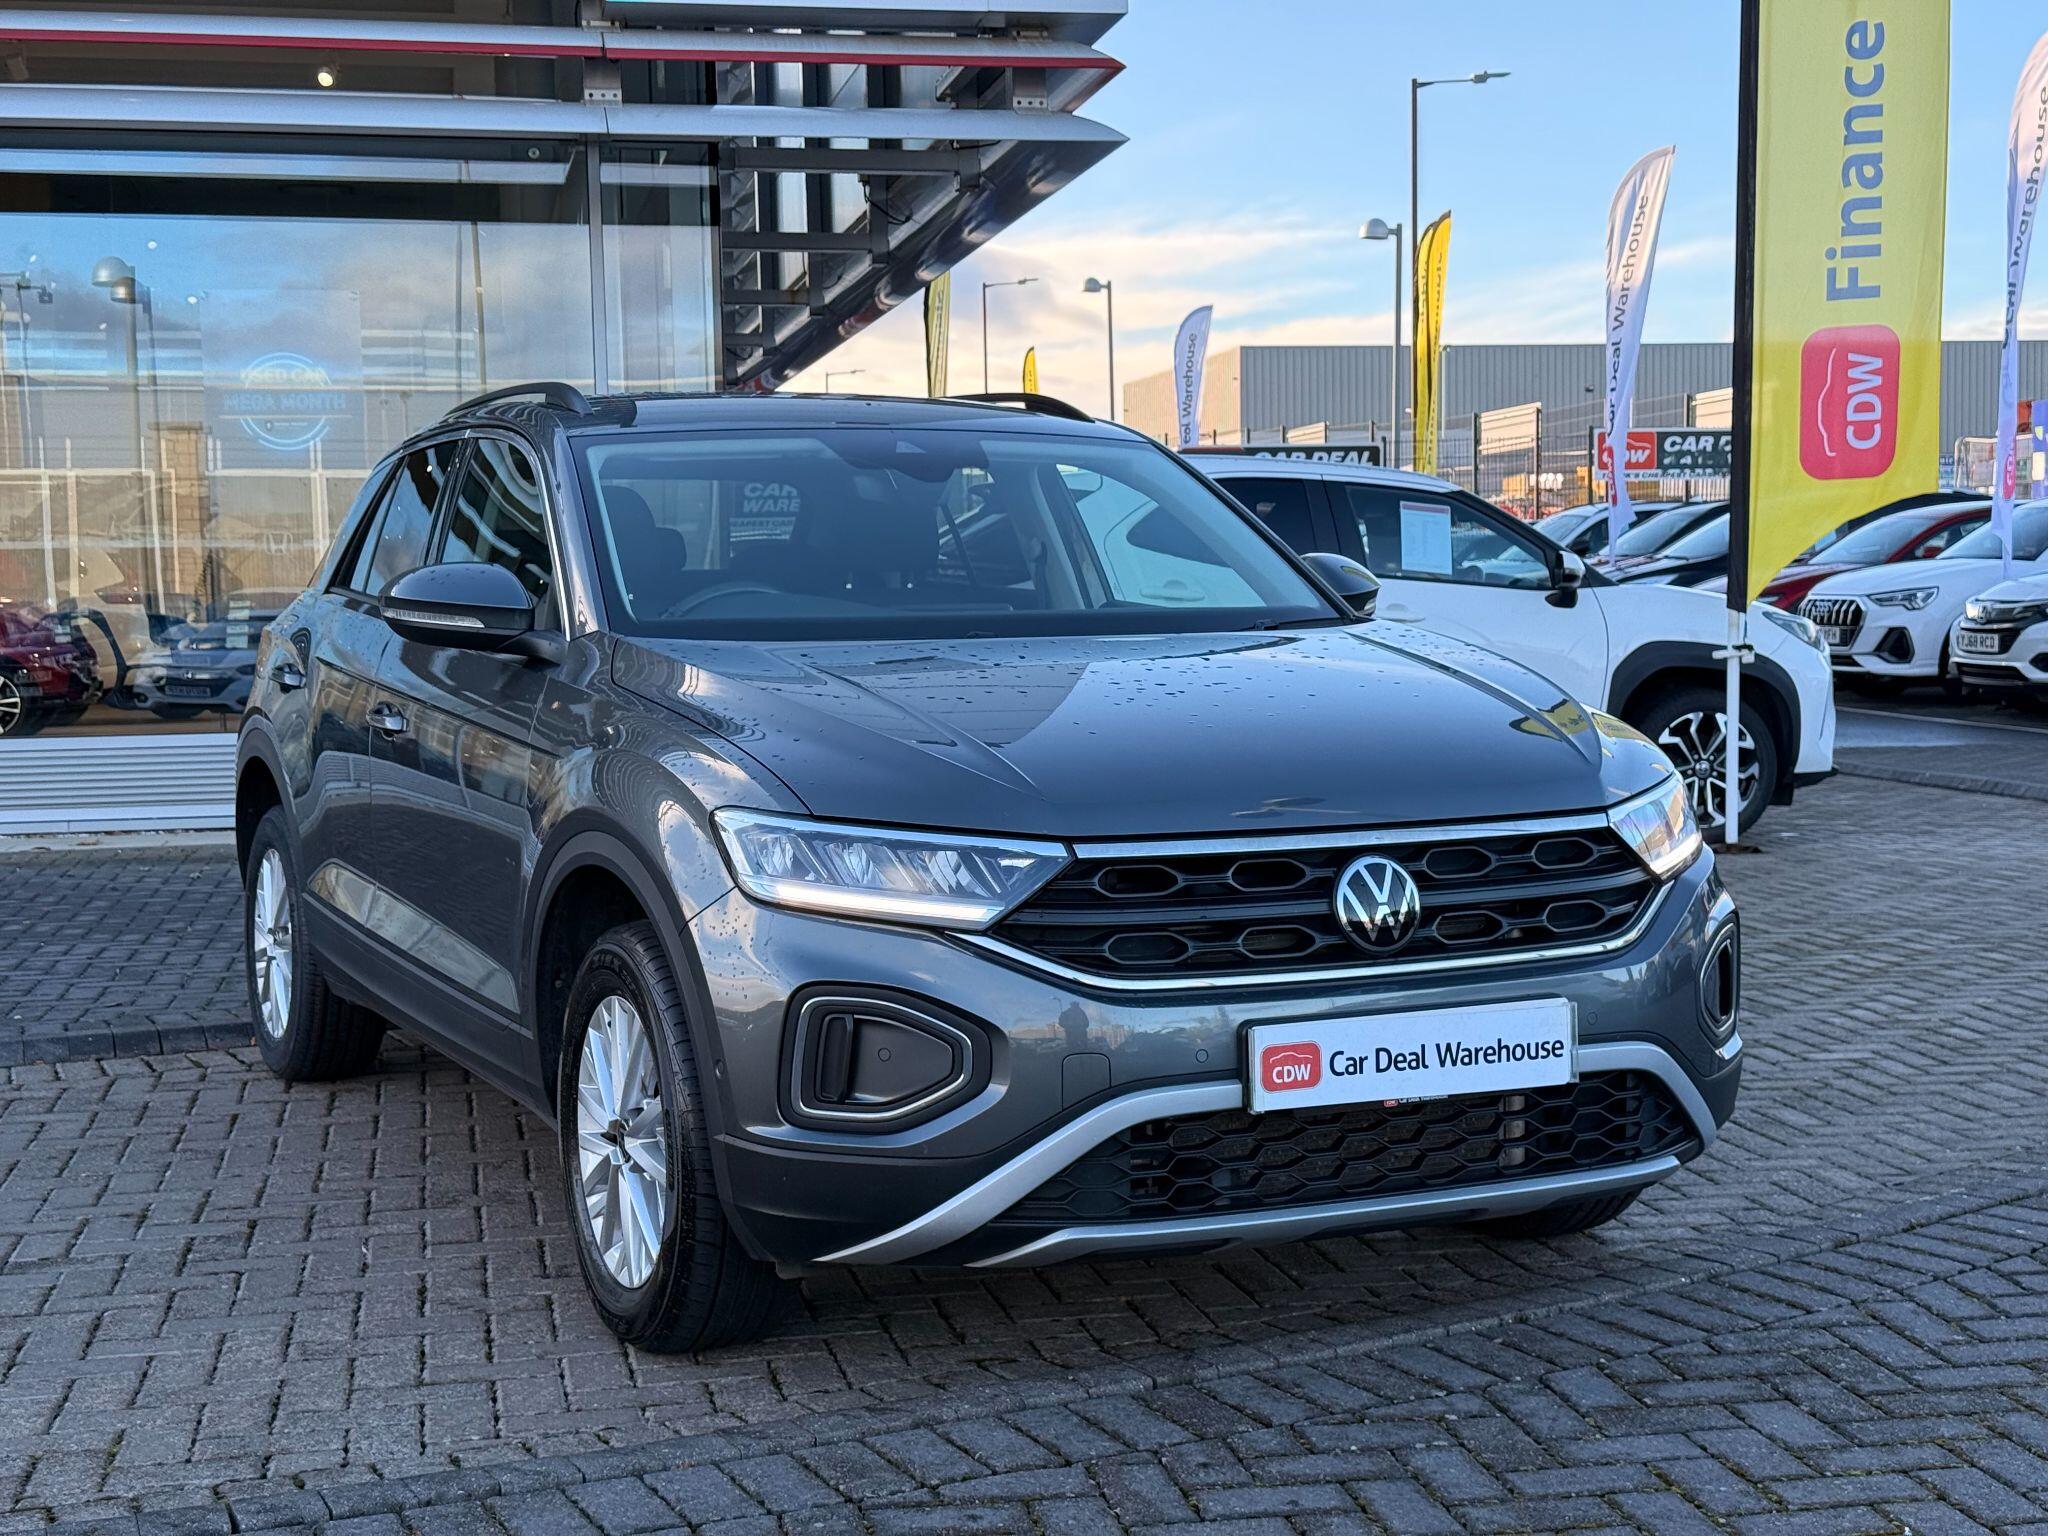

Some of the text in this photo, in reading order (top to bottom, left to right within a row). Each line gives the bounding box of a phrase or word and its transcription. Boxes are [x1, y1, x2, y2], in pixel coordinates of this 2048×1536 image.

[1825, 19, 1885, 450] CDW Finance
[1612, 194, 1649, 332] Warehouse
[280, 393, 346, 410] MONTH
[1182, 332, 1198, 445] eal Warehouse
[1664, 436, 1714, 452] CAR
[744, 483, 797, 497] CAR
[743, 499, 801, 513] WARE
[1272, 1038, 1565, 1084] CDW Car Deal Warehouse
